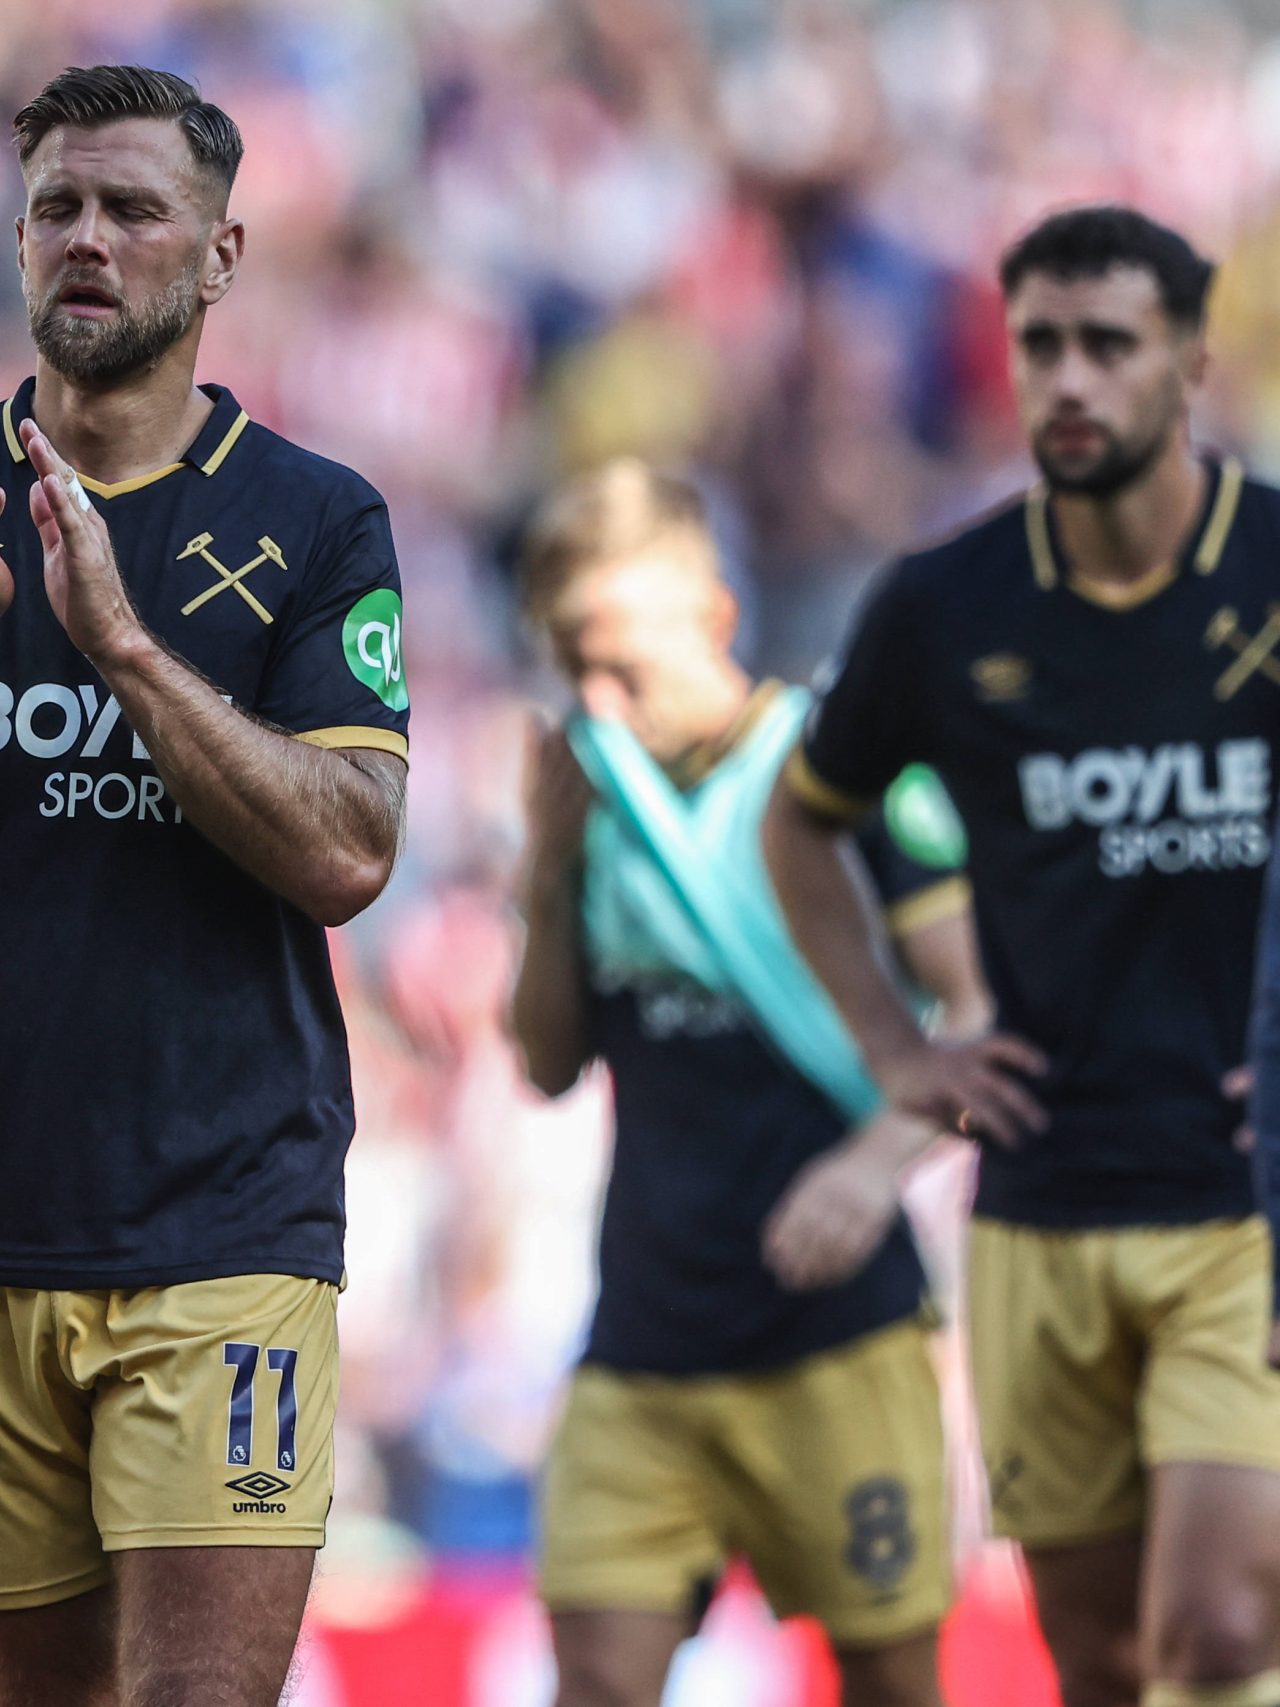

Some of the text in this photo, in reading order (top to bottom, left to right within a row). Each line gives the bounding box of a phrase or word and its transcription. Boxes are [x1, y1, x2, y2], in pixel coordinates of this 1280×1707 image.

[39, 772, 183, 824] SPOR
[1018, 738, 1270, 831] BOYLE
[223, 1342, 298, 1472] 11
[232, 1501, 287, 1514] umbro
